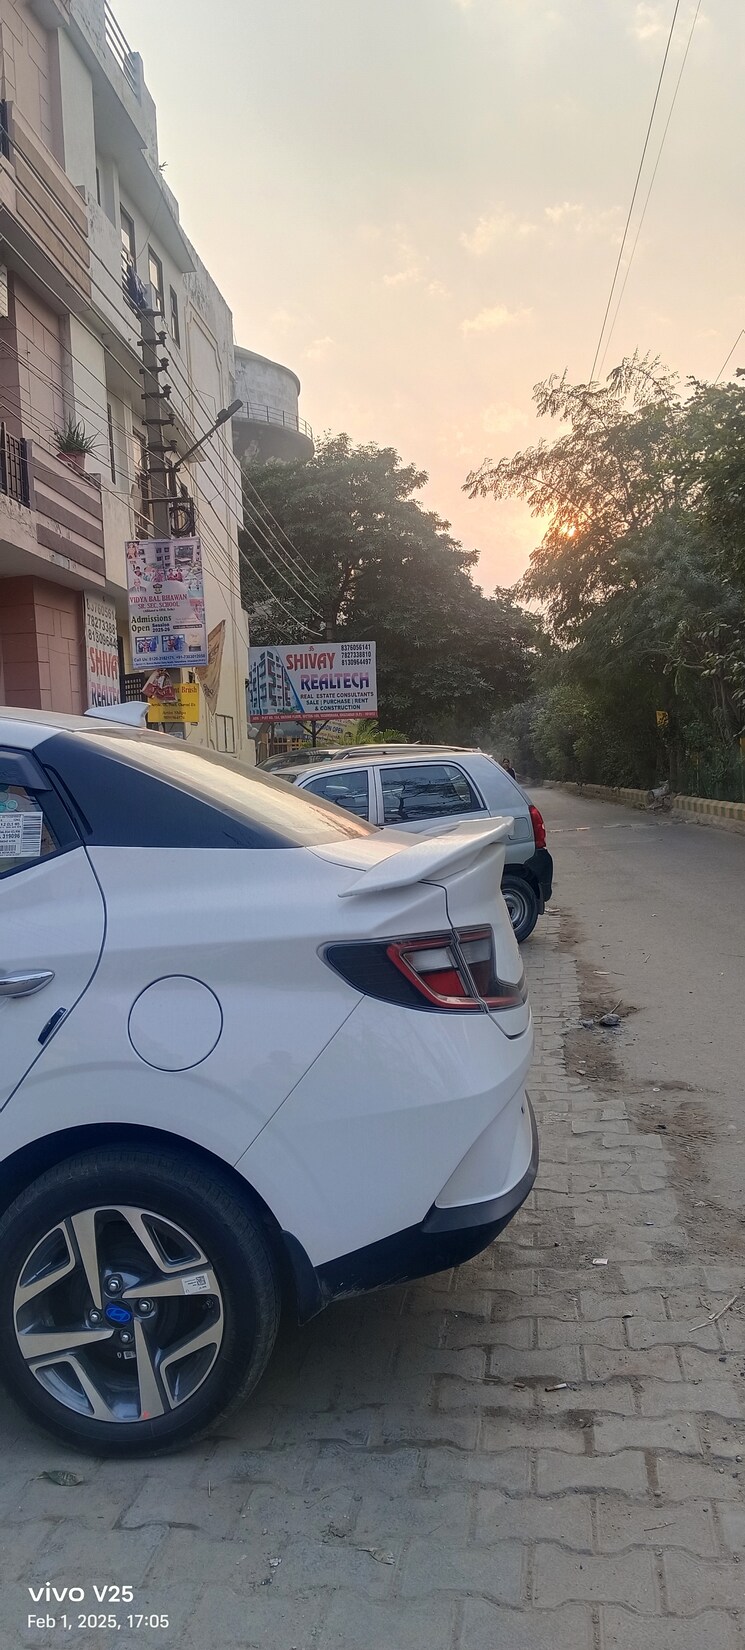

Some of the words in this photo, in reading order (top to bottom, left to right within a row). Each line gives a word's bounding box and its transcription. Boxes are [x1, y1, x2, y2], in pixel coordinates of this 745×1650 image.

[129, 596, 148, 604] VIDYA
[148, 595, 161, 603] BAL
[161, 593, 188, 602] BHAWAN
[131, 614, 172, 624] Admissions
[131, 624, 151, 633] Open
[341, 651, 372, 659] 7827338810
[285, 652, 336, 672] SHIVAY
[341, 658, 372, 666] 8130964497
[300, 672, 370, 691] REALTECH
